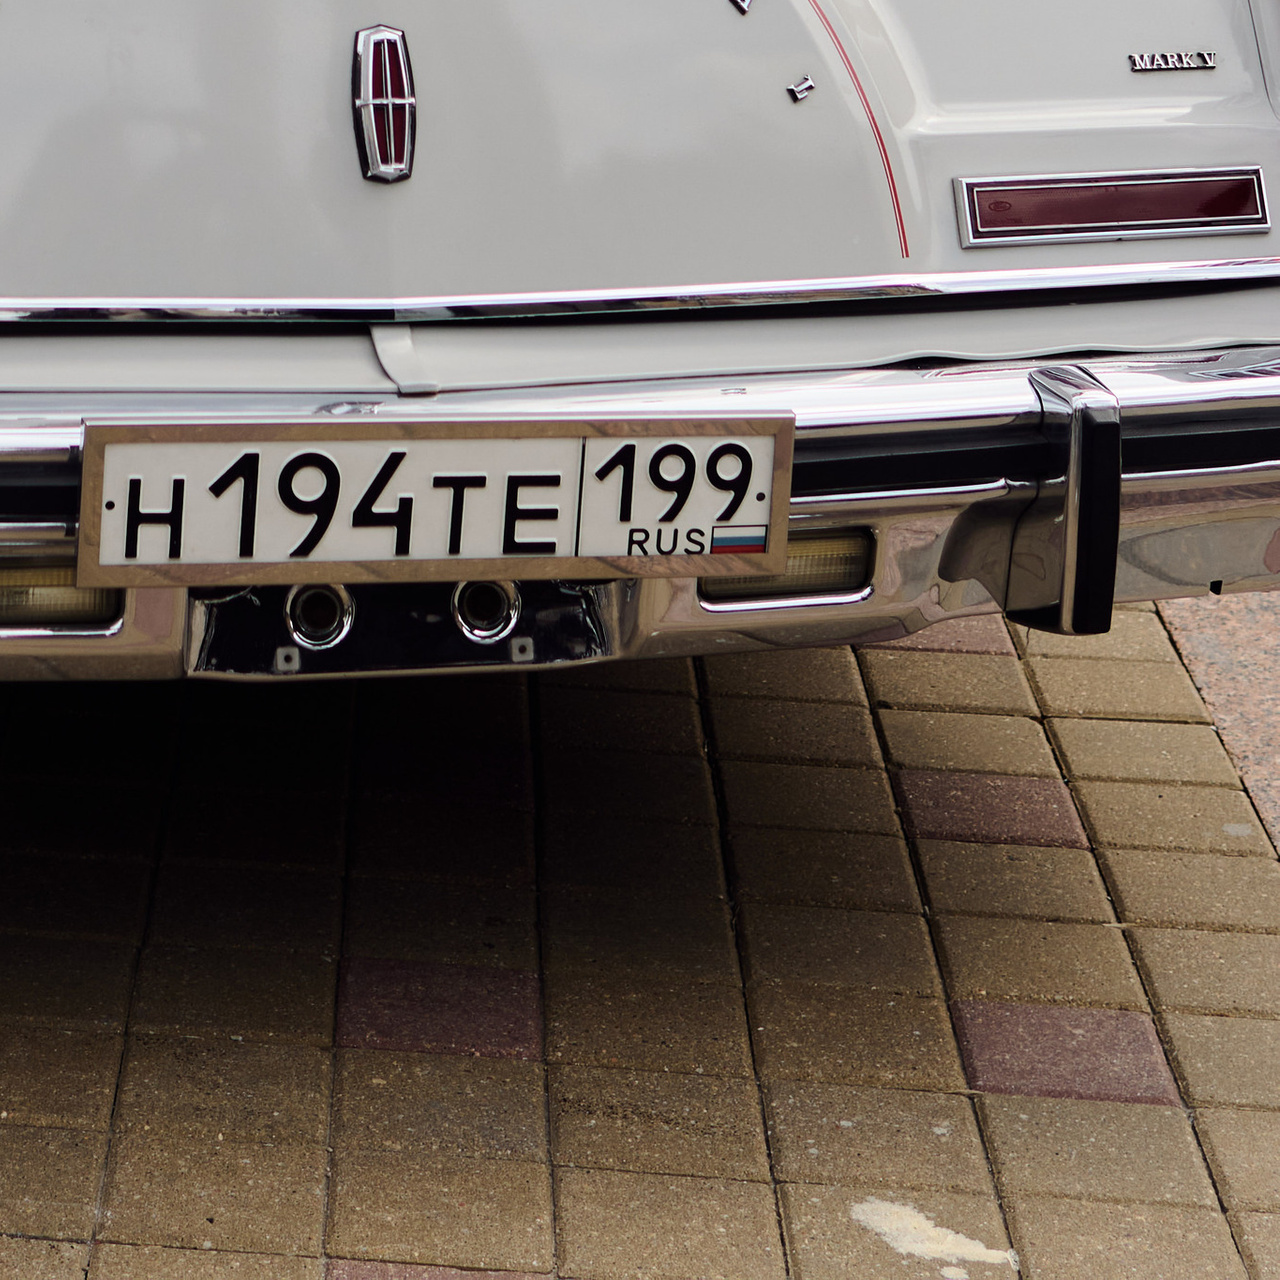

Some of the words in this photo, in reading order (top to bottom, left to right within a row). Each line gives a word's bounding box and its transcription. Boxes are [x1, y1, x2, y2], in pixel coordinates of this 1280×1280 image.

[1127, 52, 1197, 72] MARK
[1197, 50, 1217, 70] V
[593, 442, 754, 524] 199
[627, 527, 706, 557] RUS
